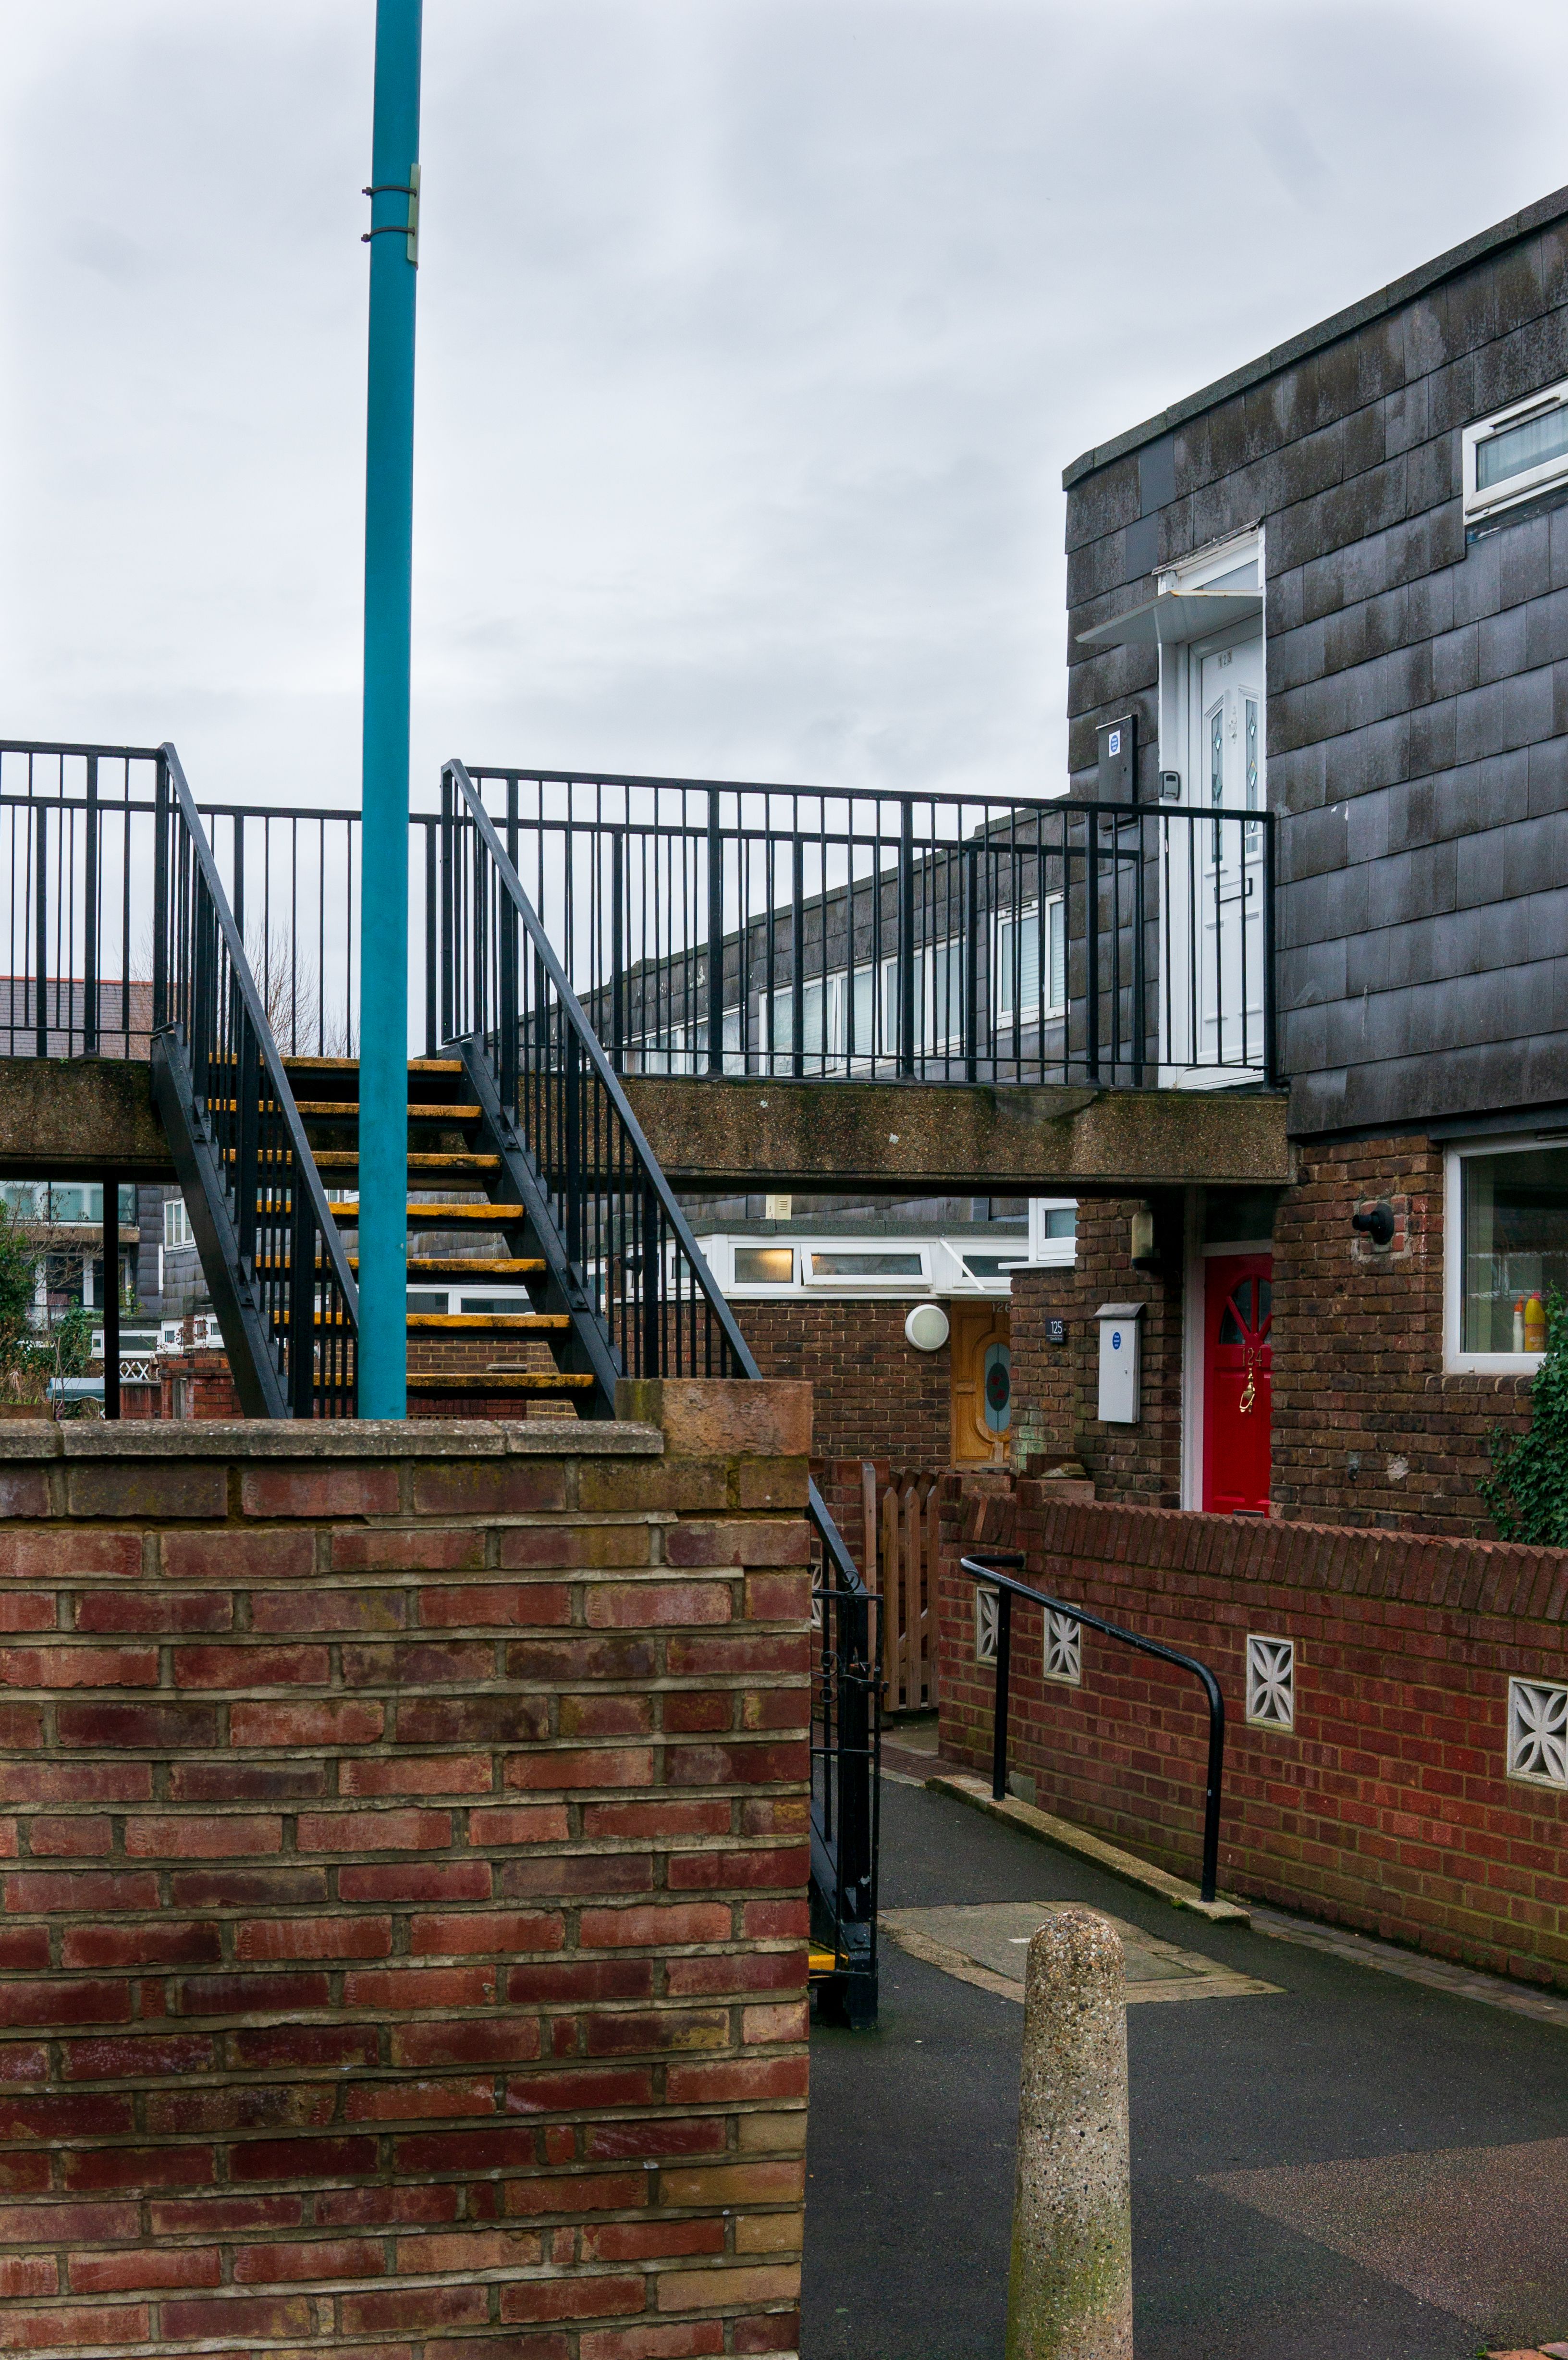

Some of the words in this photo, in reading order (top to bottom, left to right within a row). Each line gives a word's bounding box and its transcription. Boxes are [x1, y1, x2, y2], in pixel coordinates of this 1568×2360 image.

[1219, 652, 1231, 667] 123
[992, 1302, 1011, 1313] 126
[1051, 1321, 1062, 1334] 125
[1242, 1348, 1262, 1366] 124
